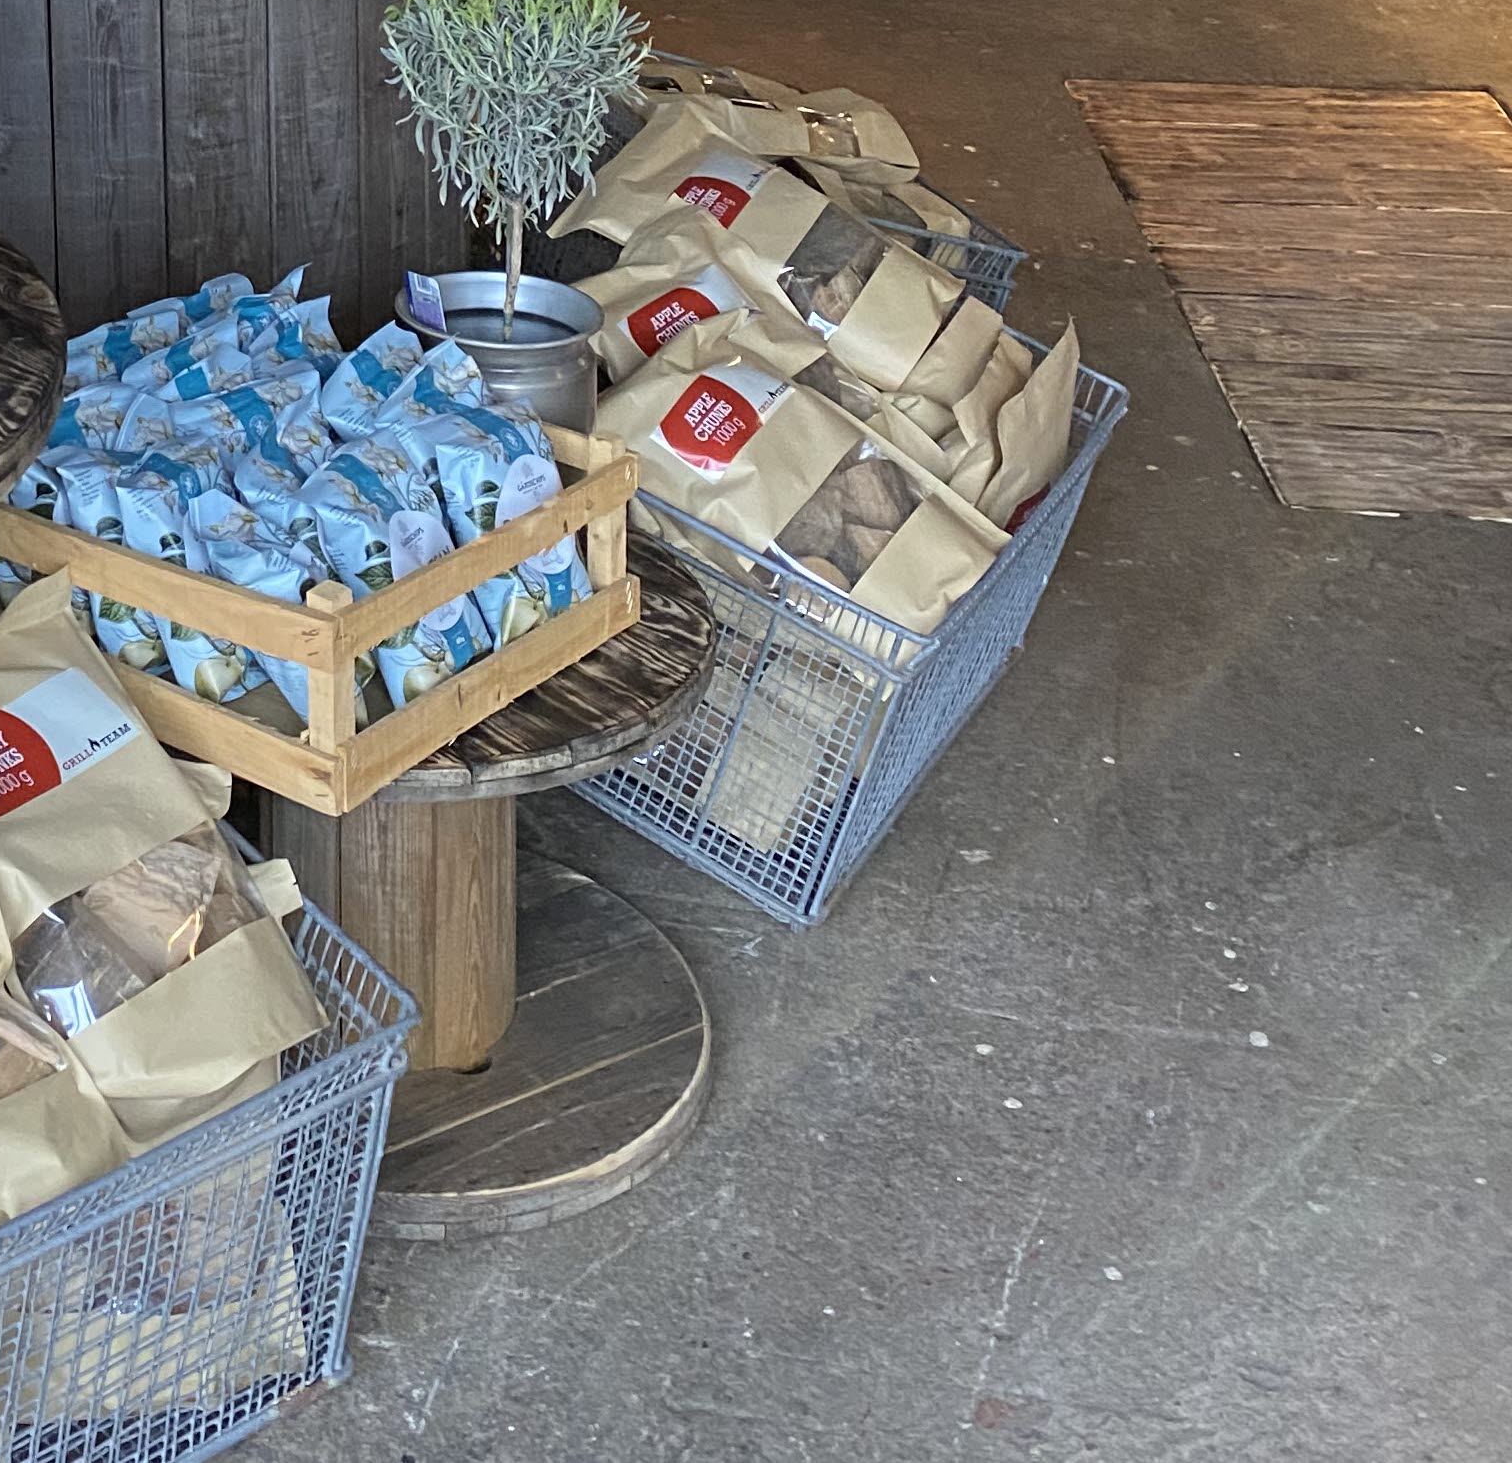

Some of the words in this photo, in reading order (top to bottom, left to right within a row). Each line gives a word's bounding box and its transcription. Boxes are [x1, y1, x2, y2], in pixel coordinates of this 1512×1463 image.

[650, 301, 686, 331] APPLE
[683, 392, 717, 428] APPLE
[694, 399, 733, 442] CHUNKS
[713, 420, 738, 447] 1000
[62, 750, 94, 771] GRILL
[100, 723, 131, 748] TEAM
[19, 770, 35, 787] g
